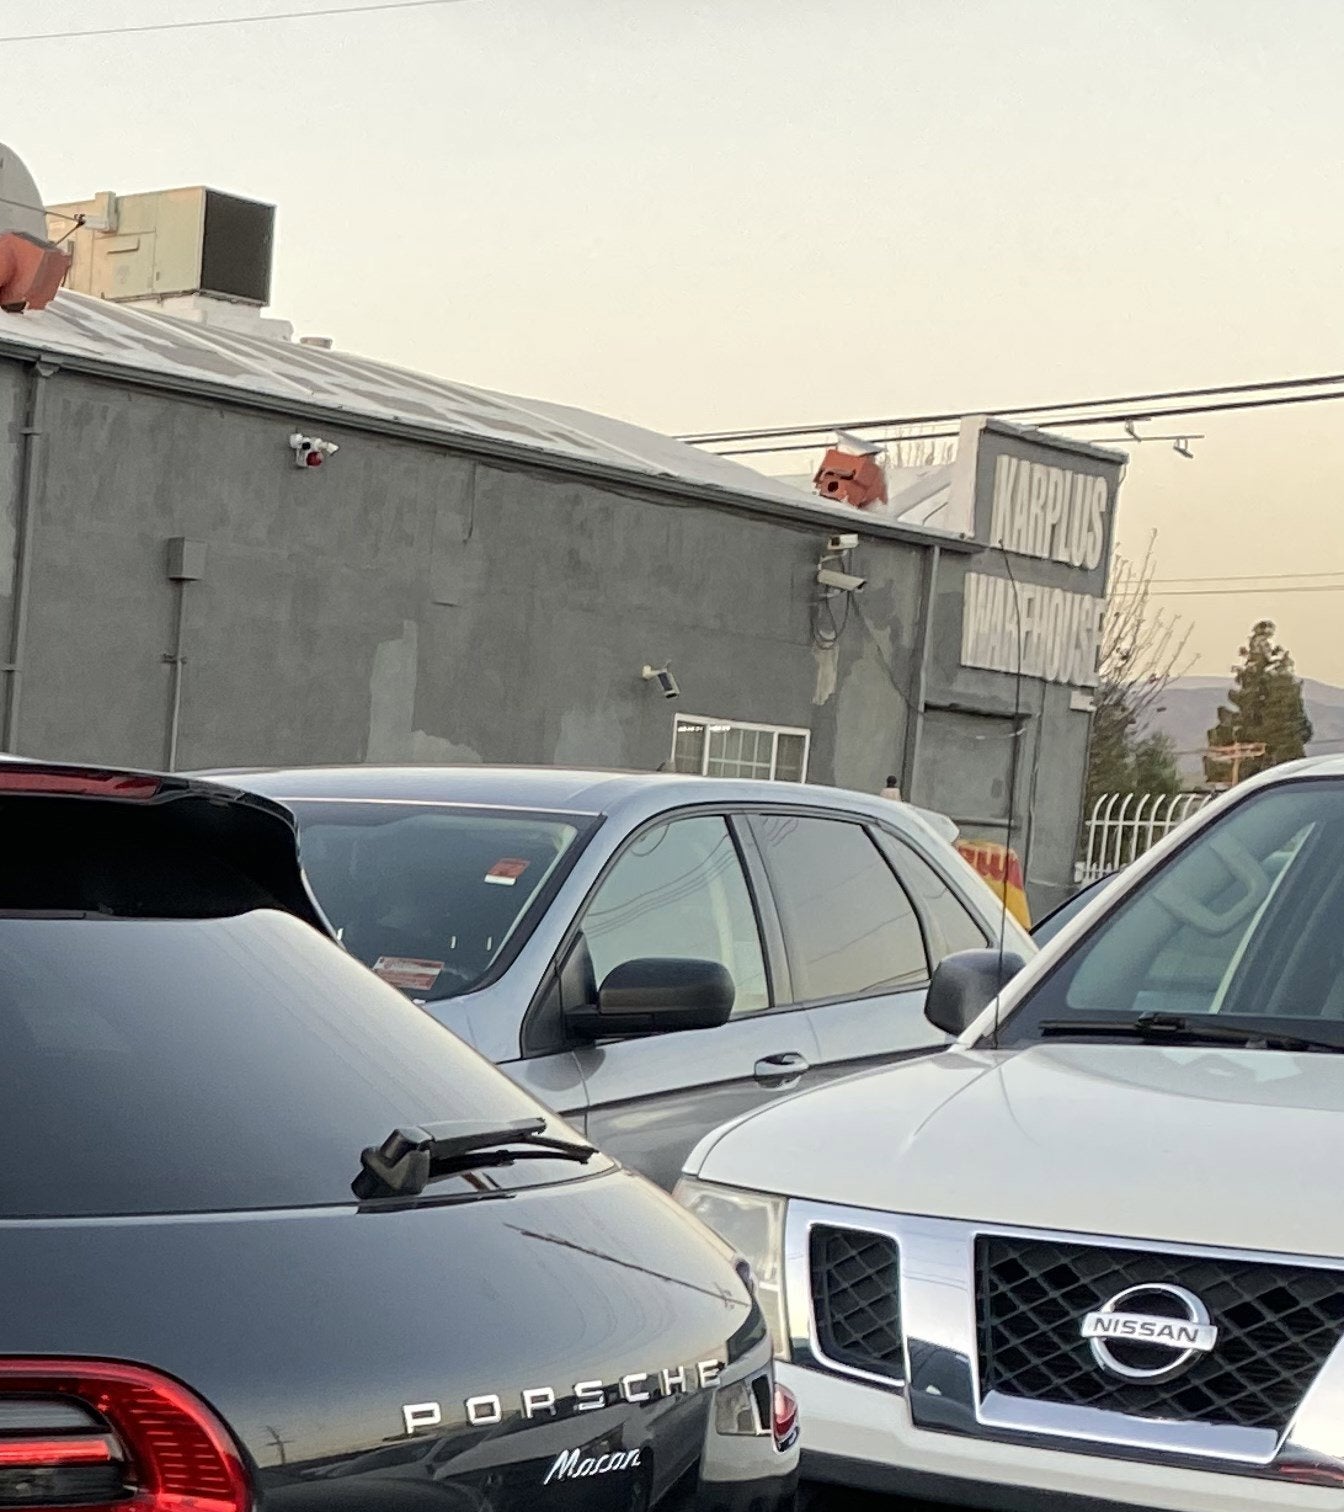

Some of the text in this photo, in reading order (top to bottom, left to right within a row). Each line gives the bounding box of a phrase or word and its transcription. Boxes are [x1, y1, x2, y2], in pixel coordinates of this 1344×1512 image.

[989, 454, 1109, 571] KARPLUS
[1092, 1317, 1200, 1343] NISSAN
[402, 1358, 725, 1434] PORSCHE
[544, 1446, 642, 1485] Macan
